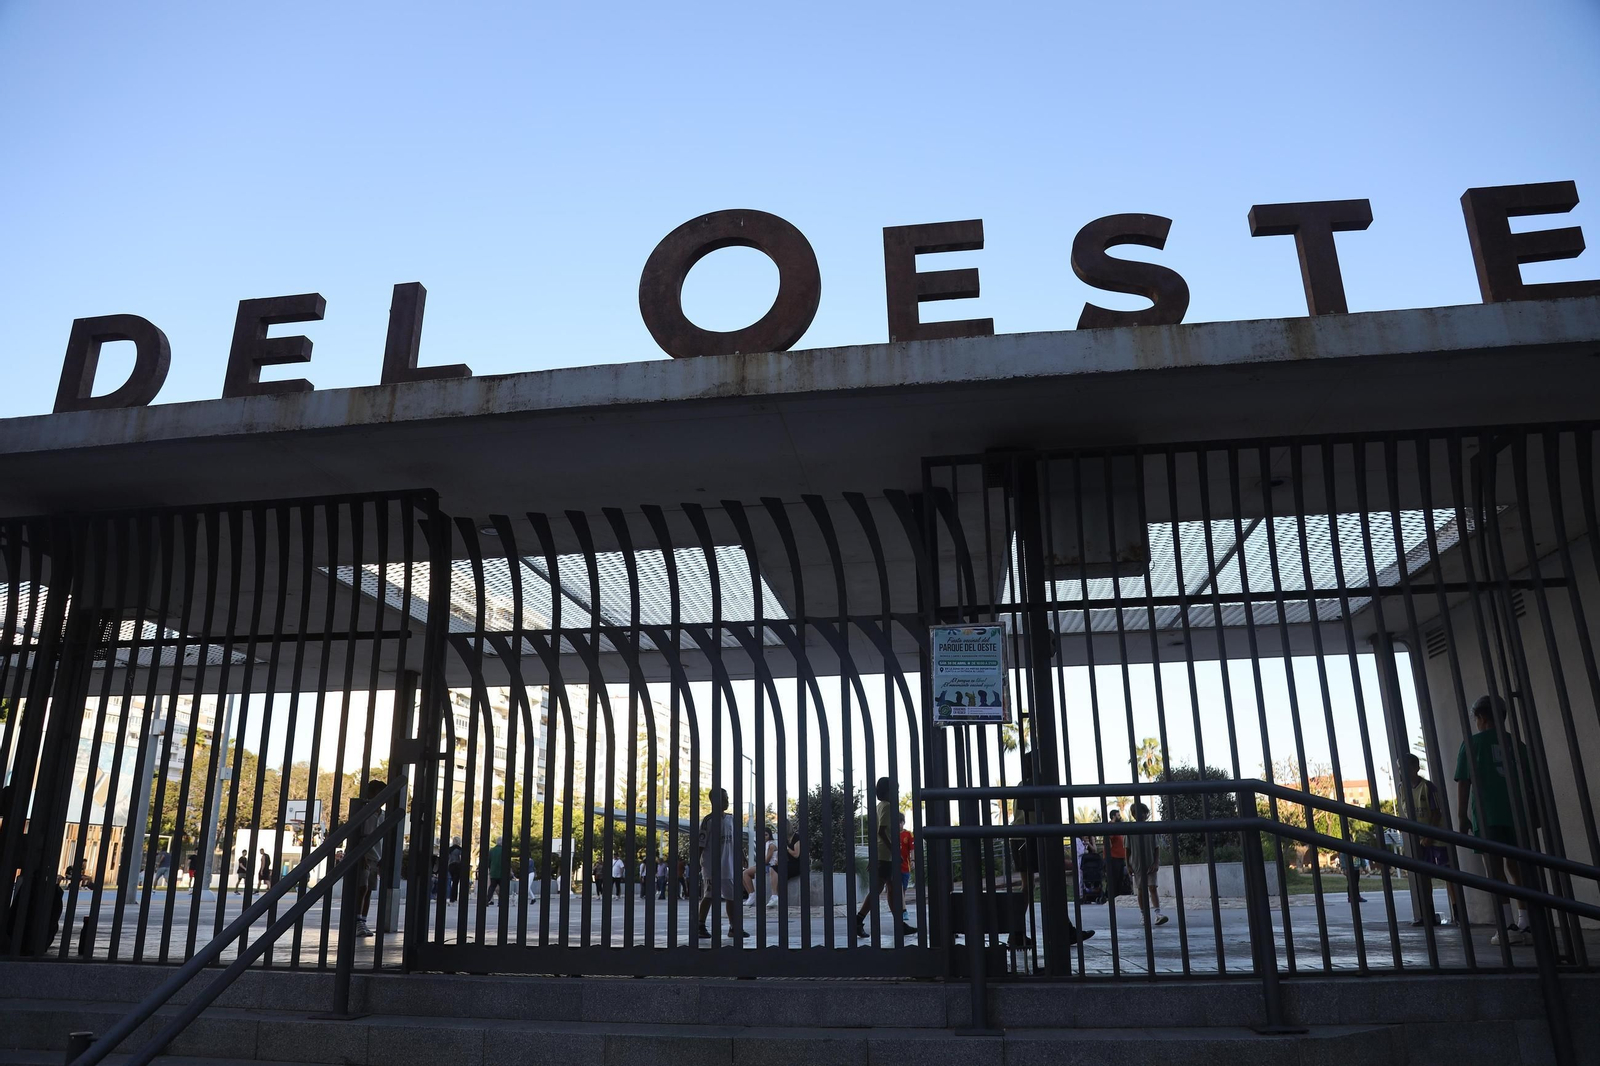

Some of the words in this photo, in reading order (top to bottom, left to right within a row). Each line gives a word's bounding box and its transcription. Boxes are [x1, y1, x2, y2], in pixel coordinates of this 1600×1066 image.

[52, 281, 473, 414] DEL
[639, 180, 1600, 359] OESTE
[939, 643, 964, 652] PARQUE
[964, 643, 976, 652] DEL
[977, 643, 997, 652] OESTE
